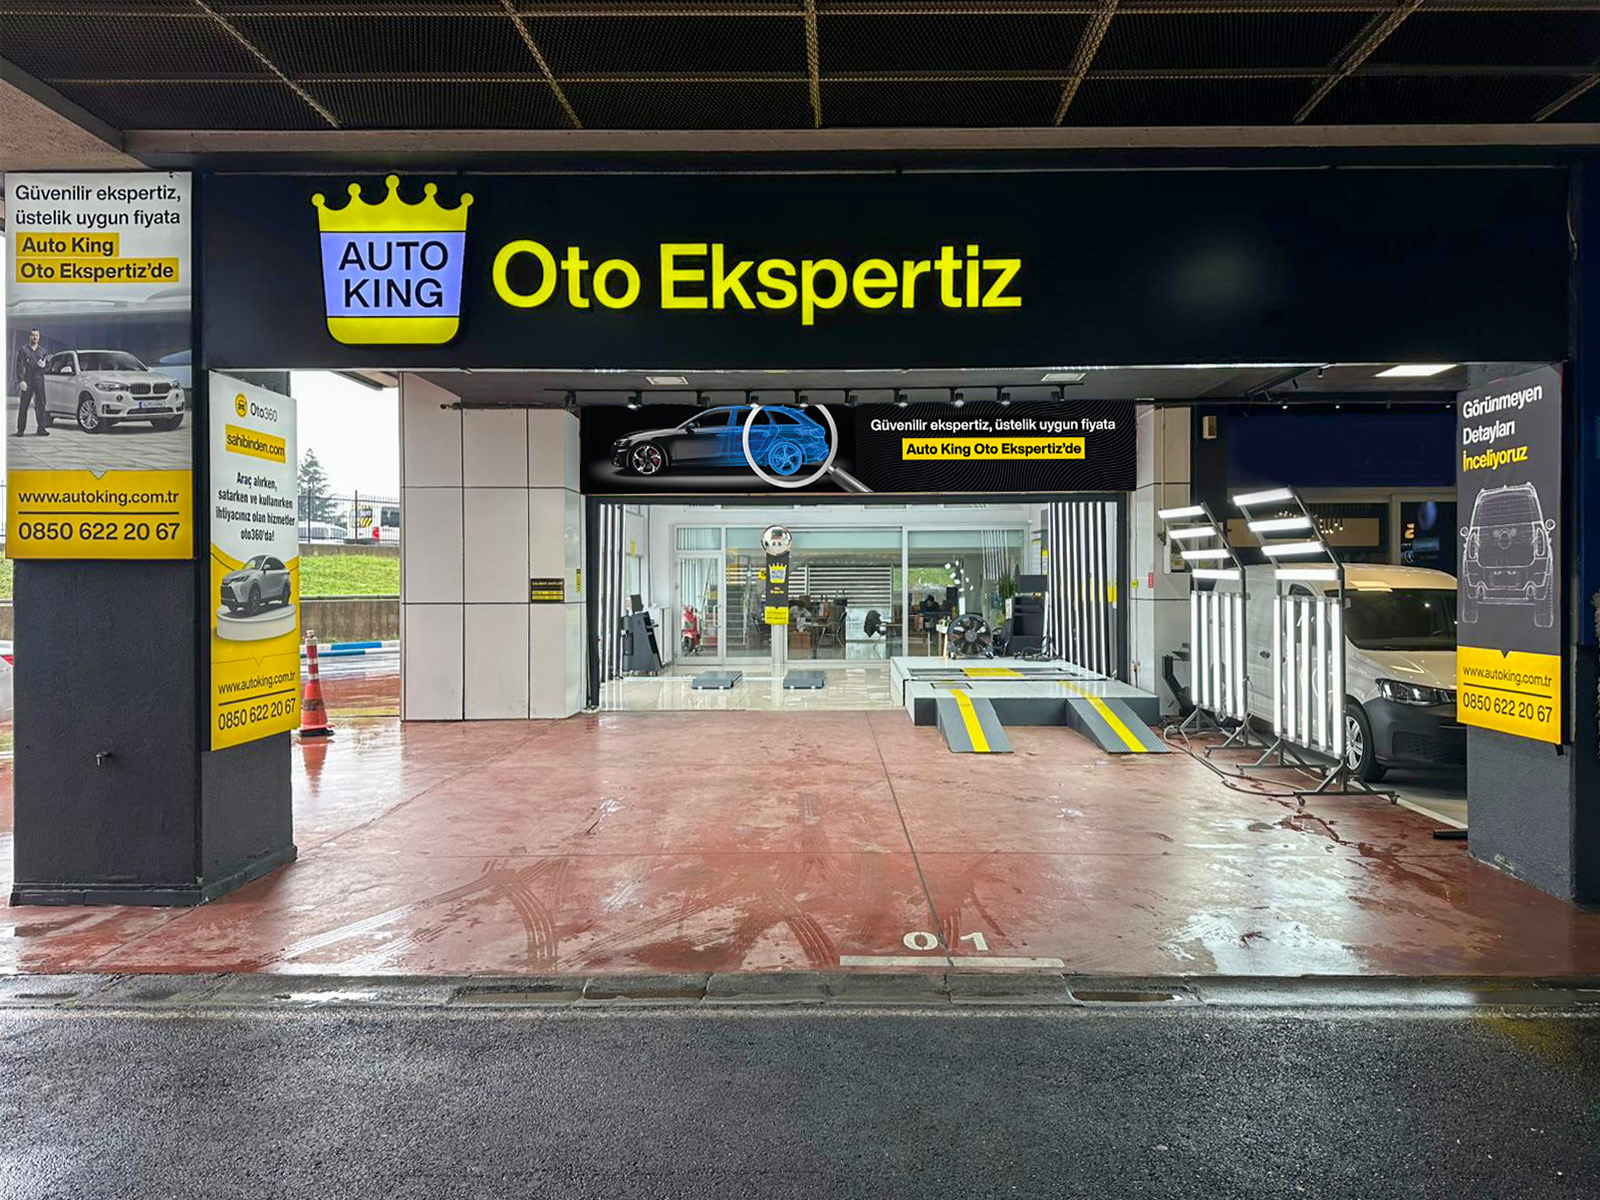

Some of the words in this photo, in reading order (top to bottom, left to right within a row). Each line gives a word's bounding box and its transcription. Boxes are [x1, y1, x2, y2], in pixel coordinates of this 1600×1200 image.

[15, 184, 92, 201] Güvenilir
[96, 184, 181, 203] ekspertiz,
[15, 210, 72, 225] üstelik
[76, 213, 129, 228] uygun
[133, 210, 180, 228] fiyata
[21, 236, 67, 253] Auto
[71, 236, 114, 256] King
[339, 240, 448, 271] AUTO
[20, 262, 55, 279] Oto
[60, 262, 174, 282] Ekspertiz'de
[492, 239, 641, 309] Oto
[660, 243, 1022, 325] Ekspertiz
[344, 278, 443, 308] KING
[250, 402, 277, 422] Oto360
[1463, 385, 1543, 419] Görünmeyen
[870, 418, 928, 431] Güvenilir
[930, 418, 993, 433] ekspertiz,
[994, 418, 1037, 431] üstelik
[1039, 420, 1078, 433] uygun
[1081, 418, 1116, 432] fiyata
[1463, 420, 1515, 445] Detayları
[226, 433, 286, 457] sahibinden.com
[906, 443, 937, 455] Auto
[940, 443, 971, 457] King
[974, 443, 998, 455] Oto
[1001, 442, 1082, 457] Ekspertiz'de
[1463, 446, 1529, 472] İnceliyoruz
[237, 472, 252, 489] Araç
[18, 490, 179, 507] www.autoking.com.tr
[218, 489, 248, 503] satarken
[250, 495, 258, 505] ve
[252, 512, 266, 523] olan
[267, 513, 295, 526] hizmetler
[18, 522, 73, 540] 0850
[79, 522, 118, 540] 622
[124, 522, 150, 540] 20
[156, 522, 180, 540] 67
[218, 671, 296, 694] www.autoking.com.tr
[1463, 666, 1552, 687] www.autoking.com.tr
[218, 709, 247, 730] 0850
[250, 703, 268, 723] 622
[271, 700, 283, 717] 20
[285, 698, 296, 714] 67
[1463, 692, 1491, 712] 0850
[1494, 698, 1515, 716] 622
[1518, 702, 1534, 720] 20
[1537, 705, 1552, 723] 67
